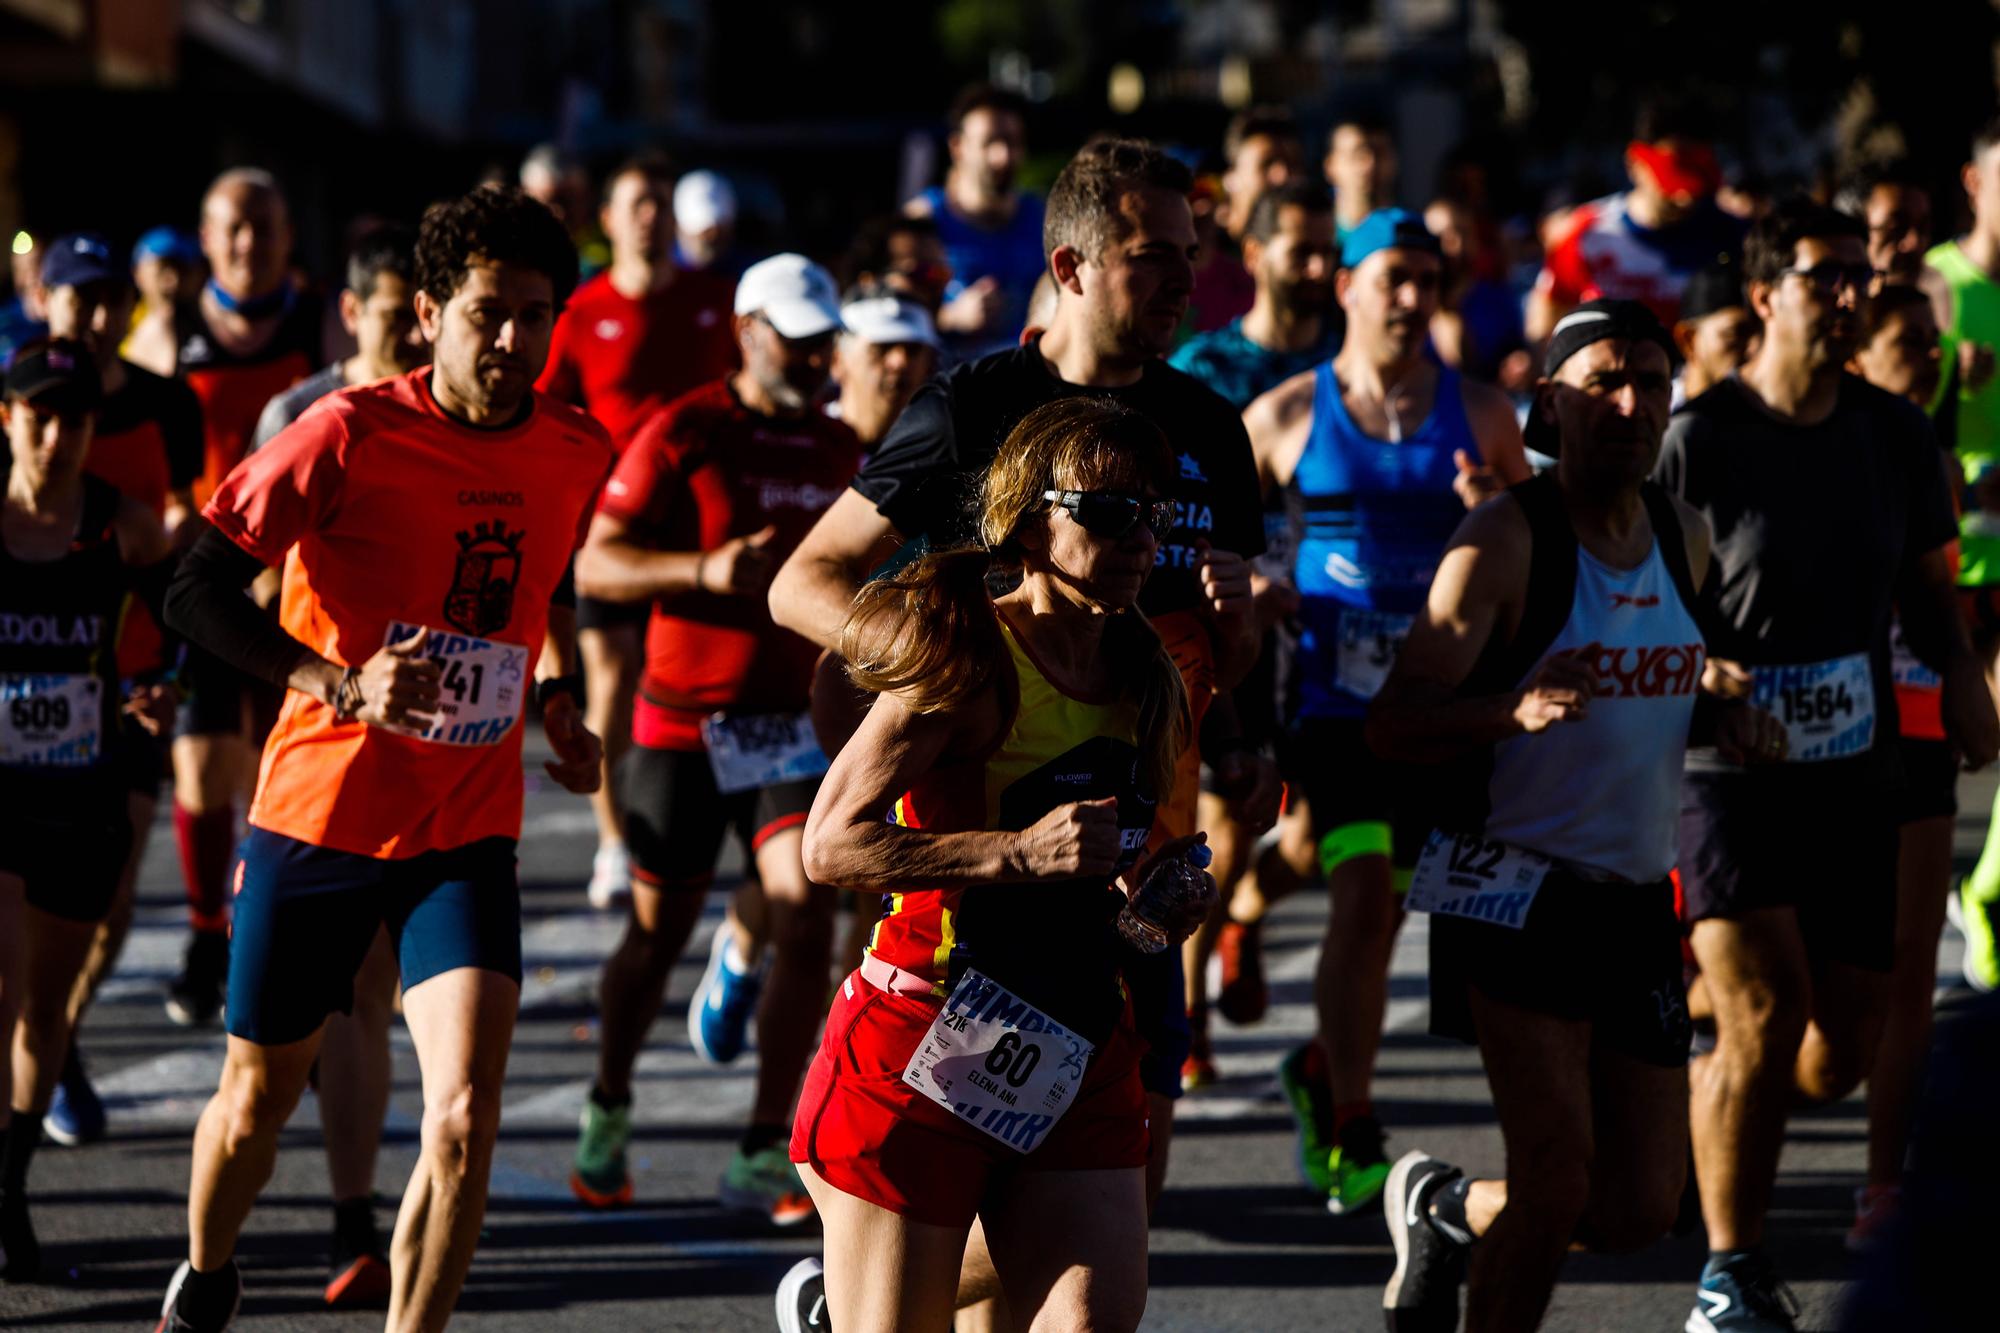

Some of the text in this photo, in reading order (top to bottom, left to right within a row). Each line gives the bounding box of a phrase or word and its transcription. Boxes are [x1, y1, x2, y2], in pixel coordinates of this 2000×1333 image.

[457, 490, 525, 508] CASINOS
[1781, 681, 1853, 723] 1564
[1448, 833, 1505, 879] 122
[984, 1032, 1041, 1087] 60
[967, 1070, 1018, 1106] ELENA ANA
